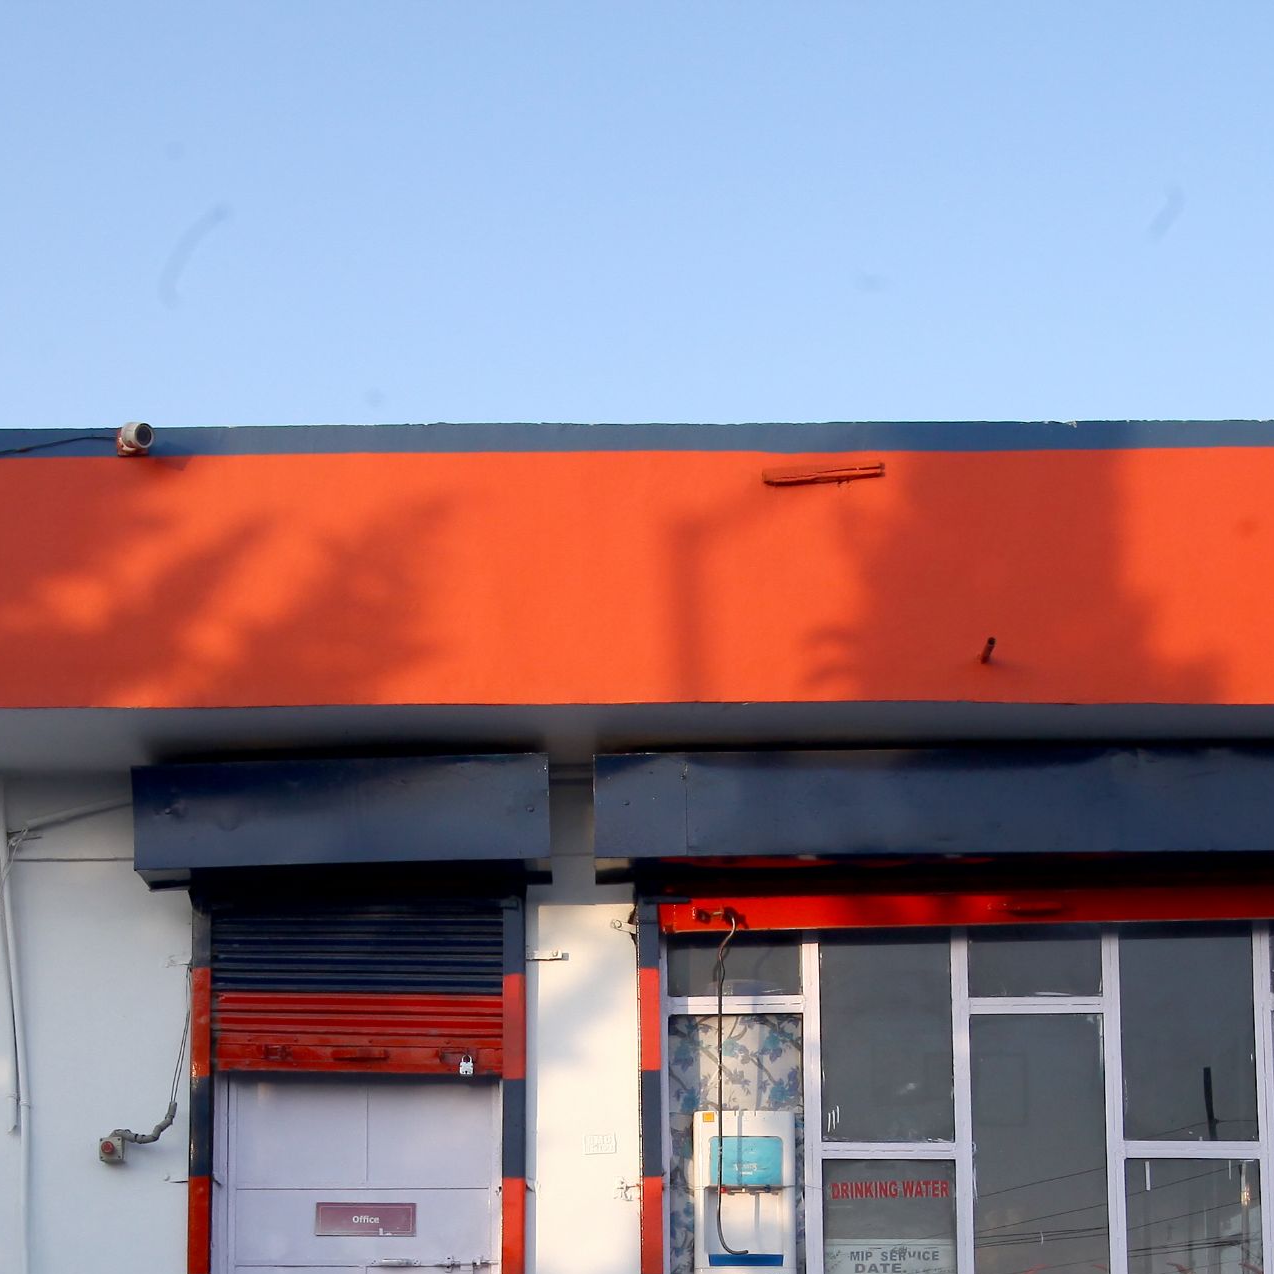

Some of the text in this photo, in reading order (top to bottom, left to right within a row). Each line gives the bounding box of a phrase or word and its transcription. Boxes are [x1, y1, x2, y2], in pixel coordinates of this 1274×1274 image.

[830, 1180, 950, 1200] DRINKING WATER
[352, 1215, 380, 1224] Office
[850, 1251, 873, 1261] MIP
